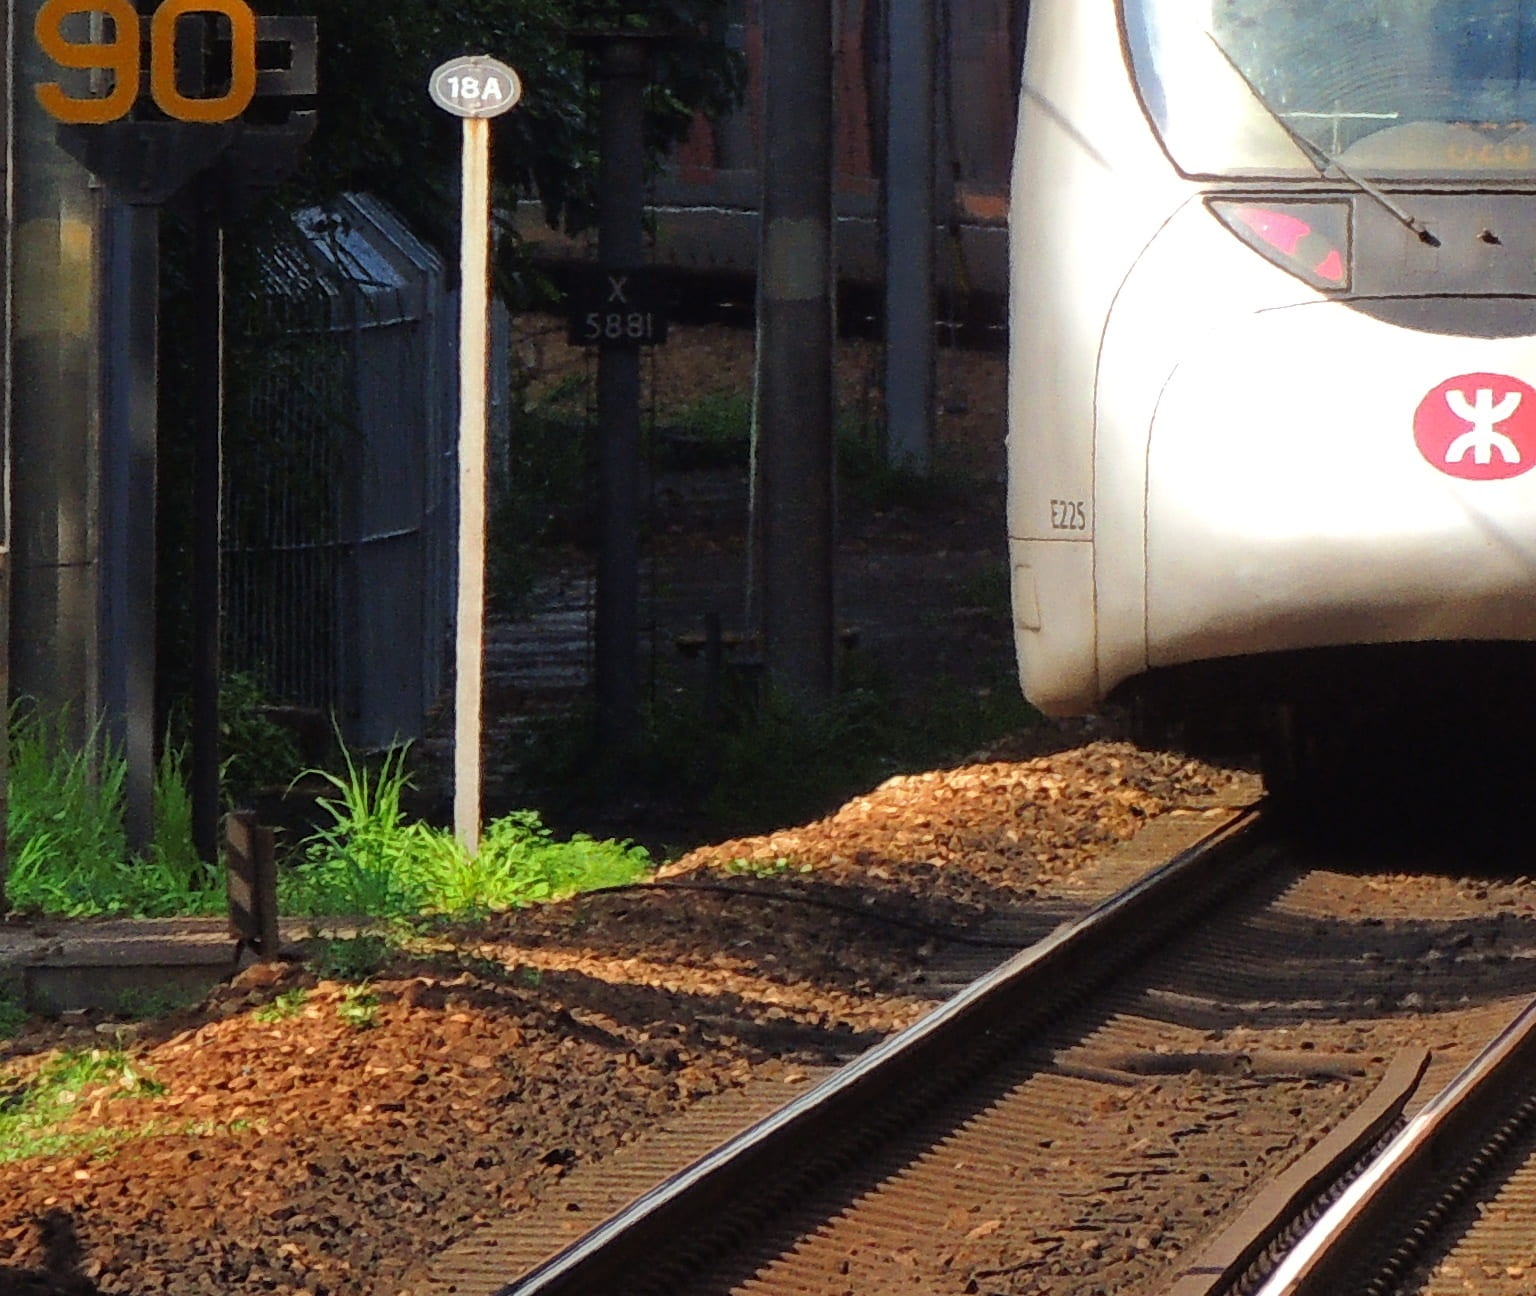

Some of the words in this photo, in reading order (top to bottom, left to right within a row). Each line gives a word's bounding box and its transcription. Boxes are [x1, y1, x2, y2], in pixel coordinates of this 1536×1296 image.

[447, 76, 502, 100] 18A
[608, 276, 627, 303] X
[584, 312, 652, 339] 5881
[1050, 499, 1086, 531] E225
